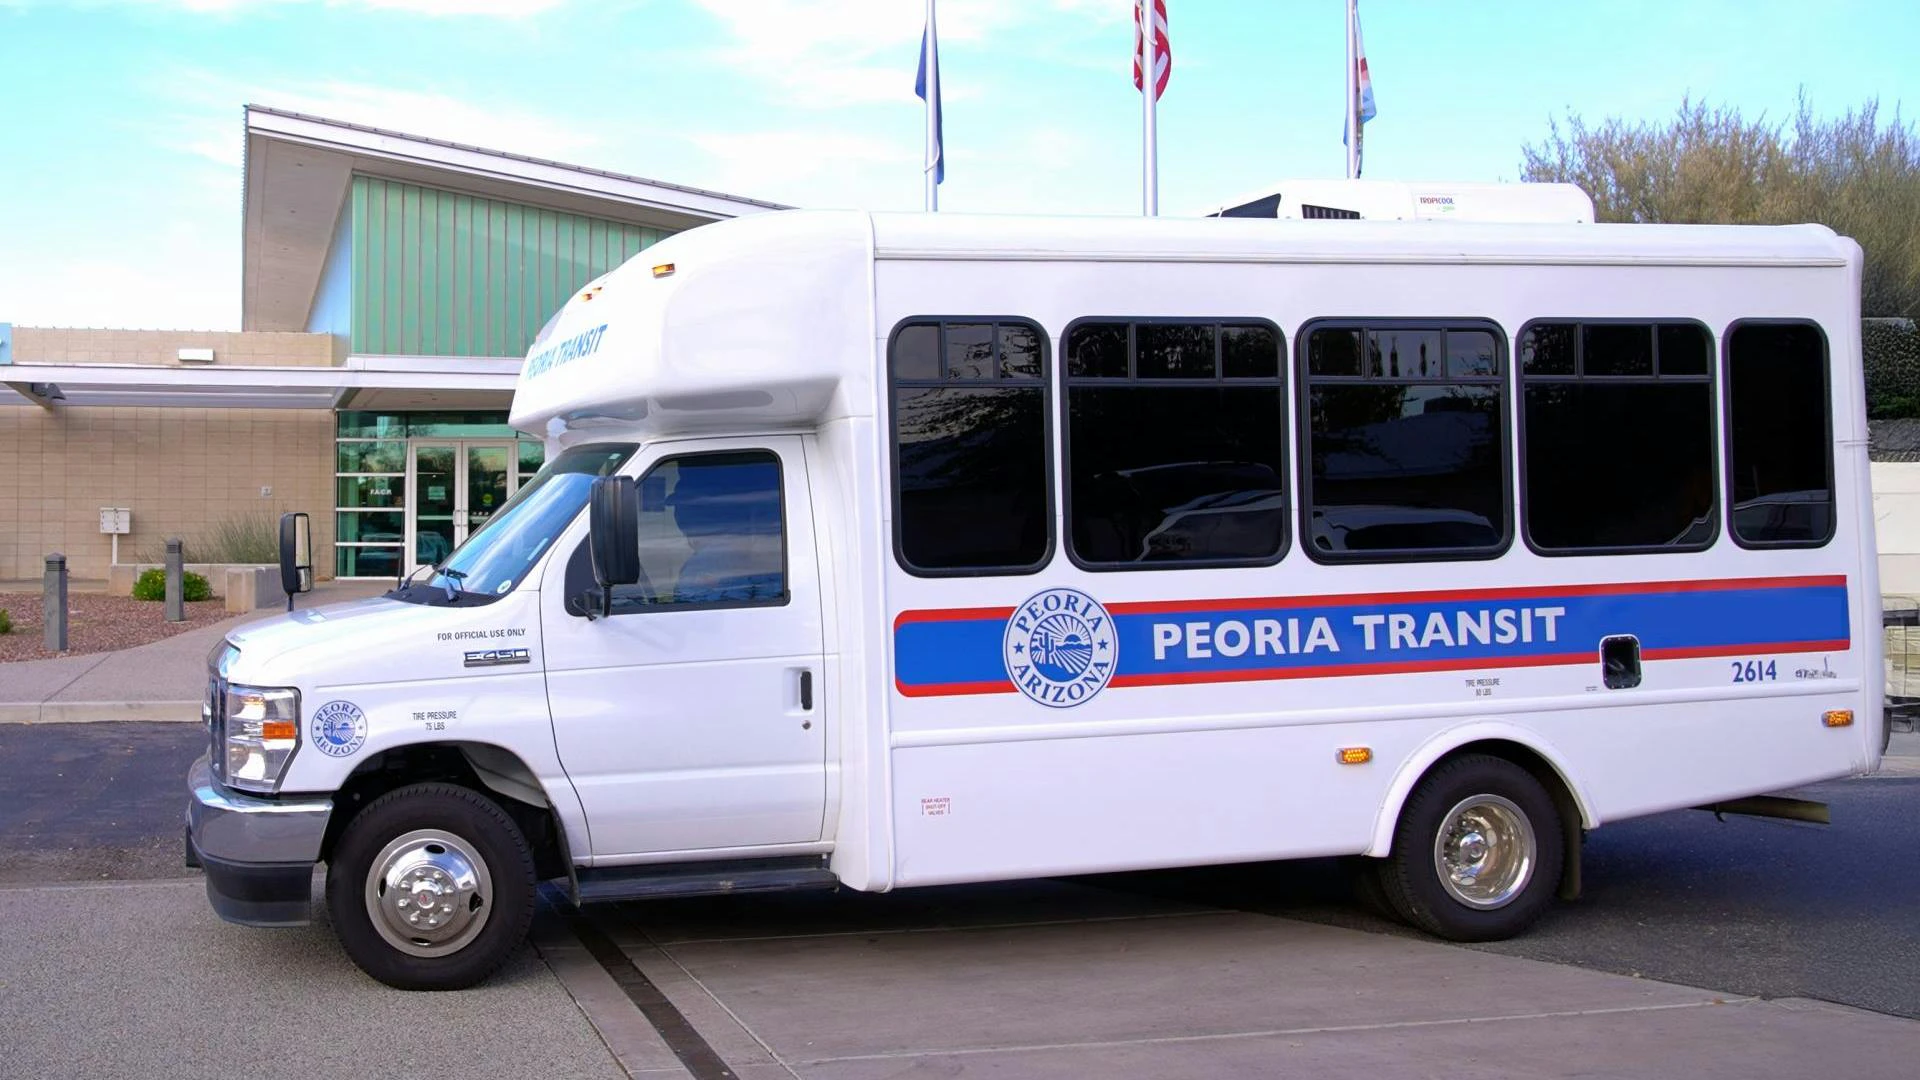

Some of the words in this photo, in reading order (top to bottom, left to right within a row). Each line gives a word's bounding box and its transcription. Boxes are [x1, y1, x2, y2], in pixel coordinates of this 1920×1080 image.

[555, 324, 608, 368] TRANSIT
[1015, 594, 1103, 634] PEORIA
[437, 632, 452, 641] FOR
[454, 630, 488, 640] OFFICIAL
[490, 629, 505, 638] USE
[507, 628, 526, 637] ONLY
[1153, 617, 1340, 660] PEORIA
[1353, 607, 1565, 650] TRANSIT
[1732, 660, 1777, 682] 2614
[1014, 662, 1109, 703] ARIZONA
[1476, 678, 1500, 687] PRESSURE
[316, 703, 361, 721] PEORIA
[412, 712, 425, 720] TIRE
[427, 710, 457, 720] PRESSURE
[425, 722, 432, 730] 75
[434, 722, 445, 730] LBS
[315, 736, 363, 755] ARIZONA
